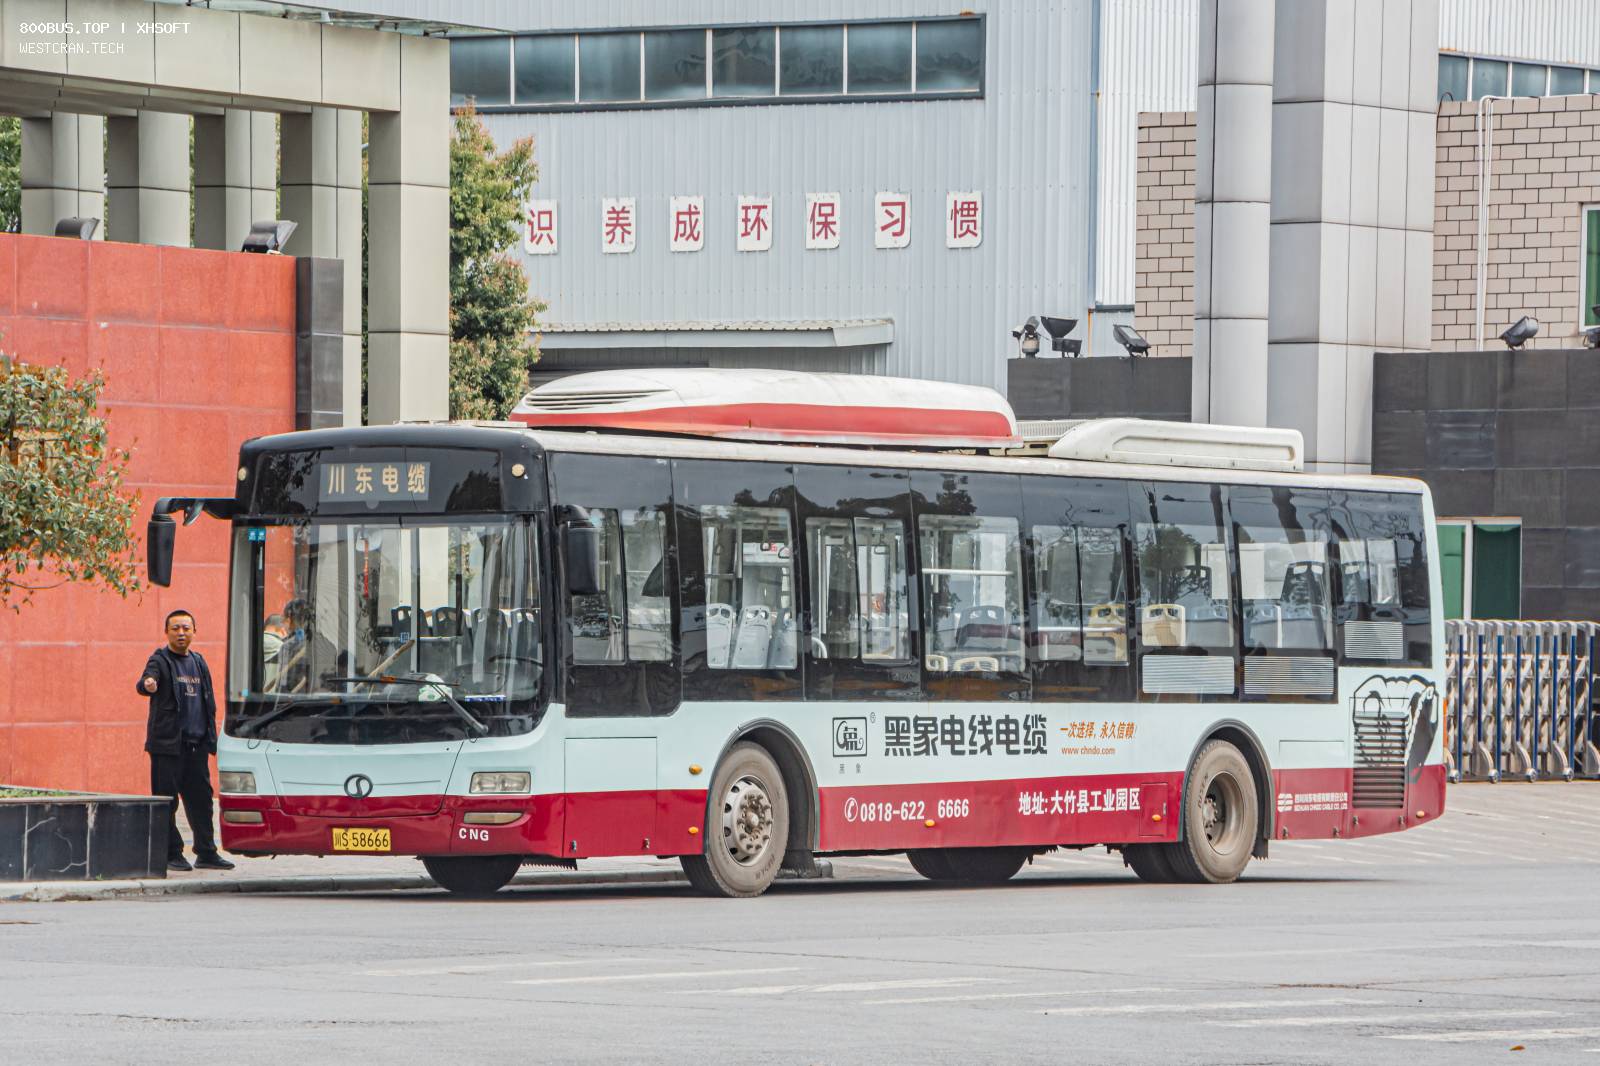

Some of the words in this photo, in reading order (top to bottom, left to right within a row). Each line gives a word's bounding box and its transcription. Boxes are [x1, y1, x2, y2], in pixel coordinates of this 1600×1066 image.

[328, 463, 426, 495] 川东电缆
[884, 714, 1048, 757] 黑象电线电缆
[860, 801, 925, 822] 0818-622
[937, 798, 969, 818] 6666
[458, 827, 489, 842] CNG
